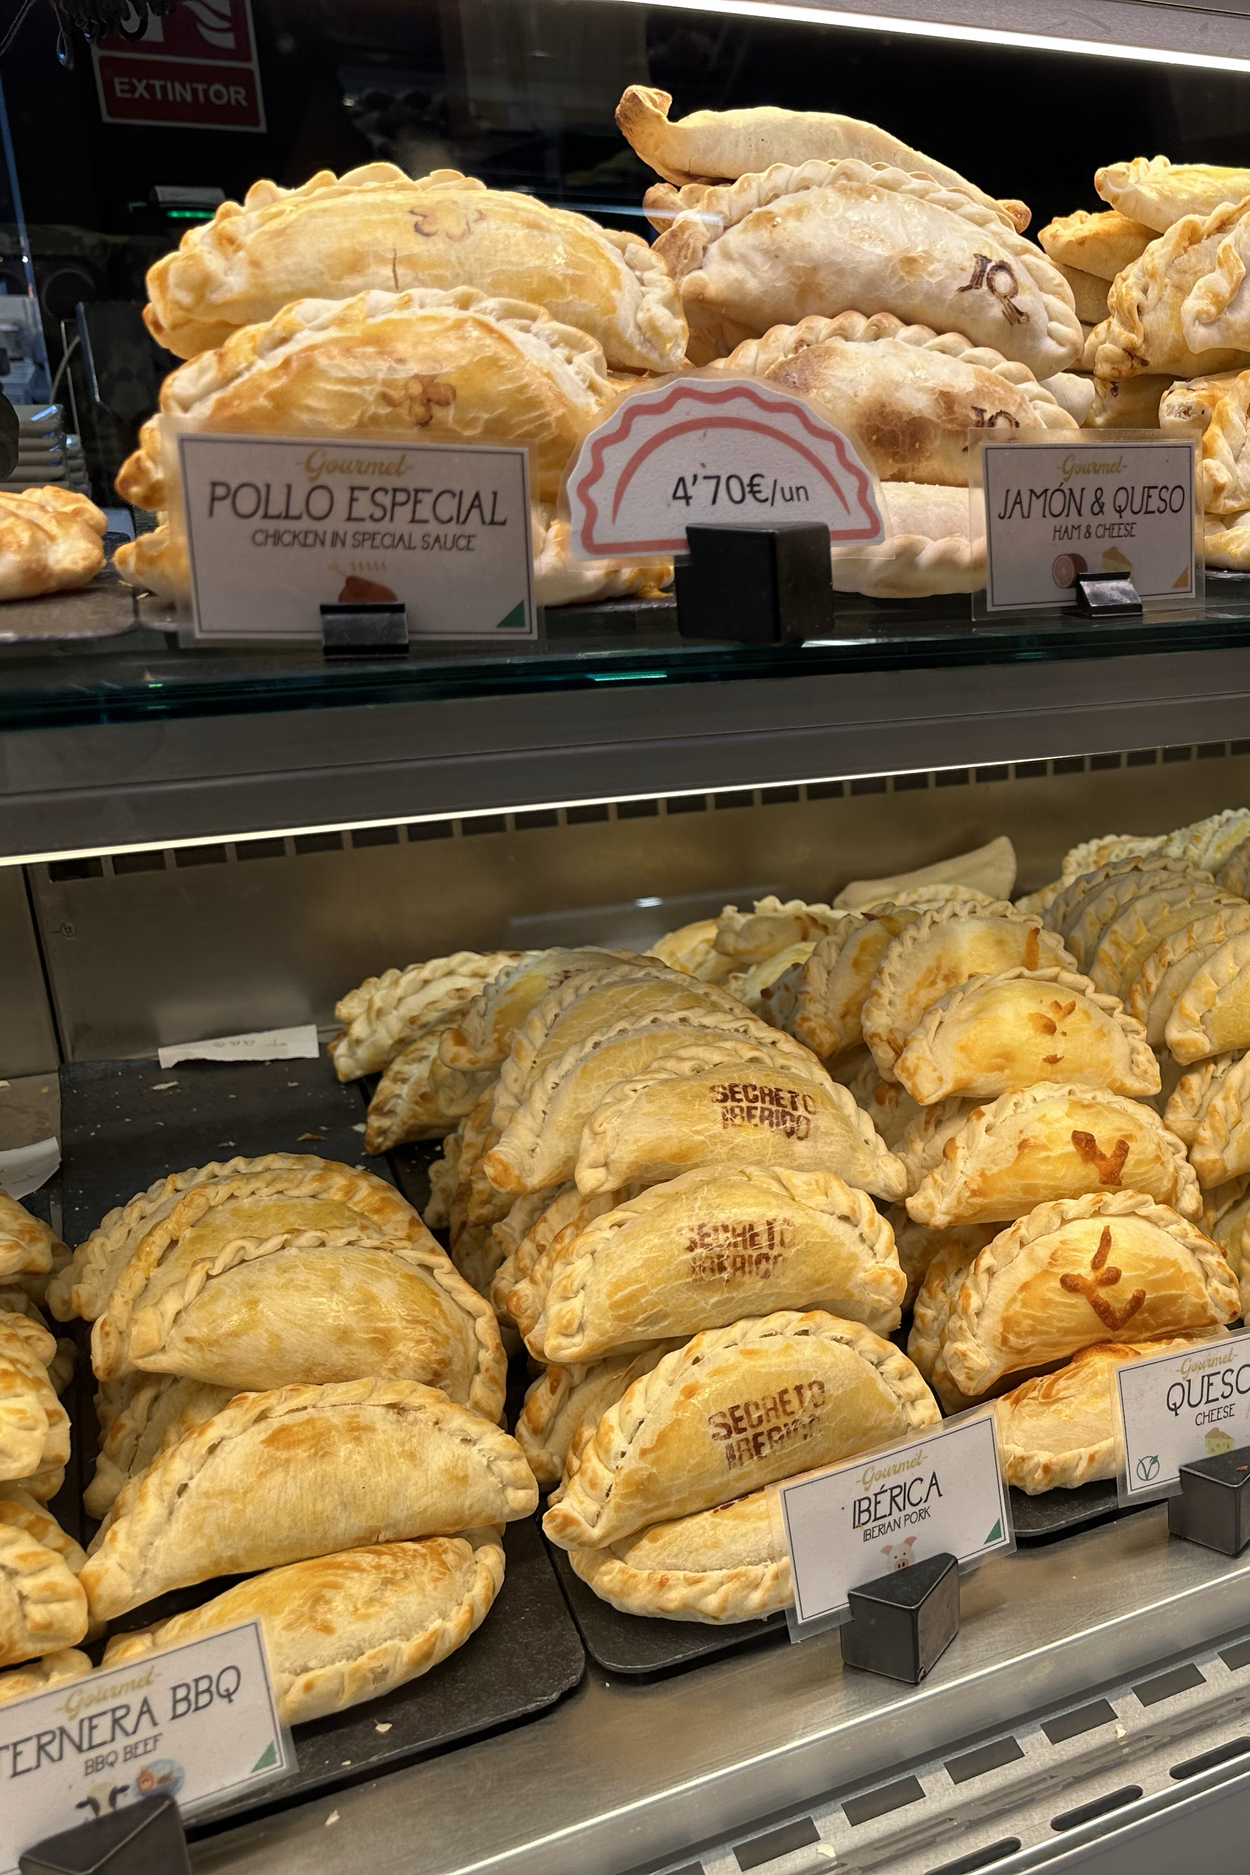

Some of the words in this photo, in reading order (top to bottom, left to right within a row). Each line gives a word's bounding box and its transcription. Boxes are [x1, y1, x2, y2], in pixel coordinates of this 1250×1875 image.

[113, 76, 249, 107] EXTINTOR
[208, 481, 335, 522] POLLO
[344, 485, 508, 527] ESPECIAL
[997, 482, 1087, 520] JAMÓN
[1090, 487, 1105, 516] &
[1113, 485, 1185, 519] QUESO
[252, 529, 327, 548] CHICKEN
[330, 530, 348, 548] IN
[351, 531, 418, 550] SPECIAL
[421, 532, 478, 551] SAUCE
[1052, 525, 1083, 541] HAM
[1084, 524, 1092, 539] &
[1095, 522, 1138, 539] CHEESE
[1195, 1402, 1236, 1426] CHEESE
[852, 1471, 943, 1529] IBÉRICA
[862, 1517, 901, 1542] IBERIAN
[903, 1506, 932, 1528] PORK
[170, 1665, 241, 1721] BBQ
[84, 1750, 118, 1777] BBQ
[122, 1732, 163, 1764] BEEF
